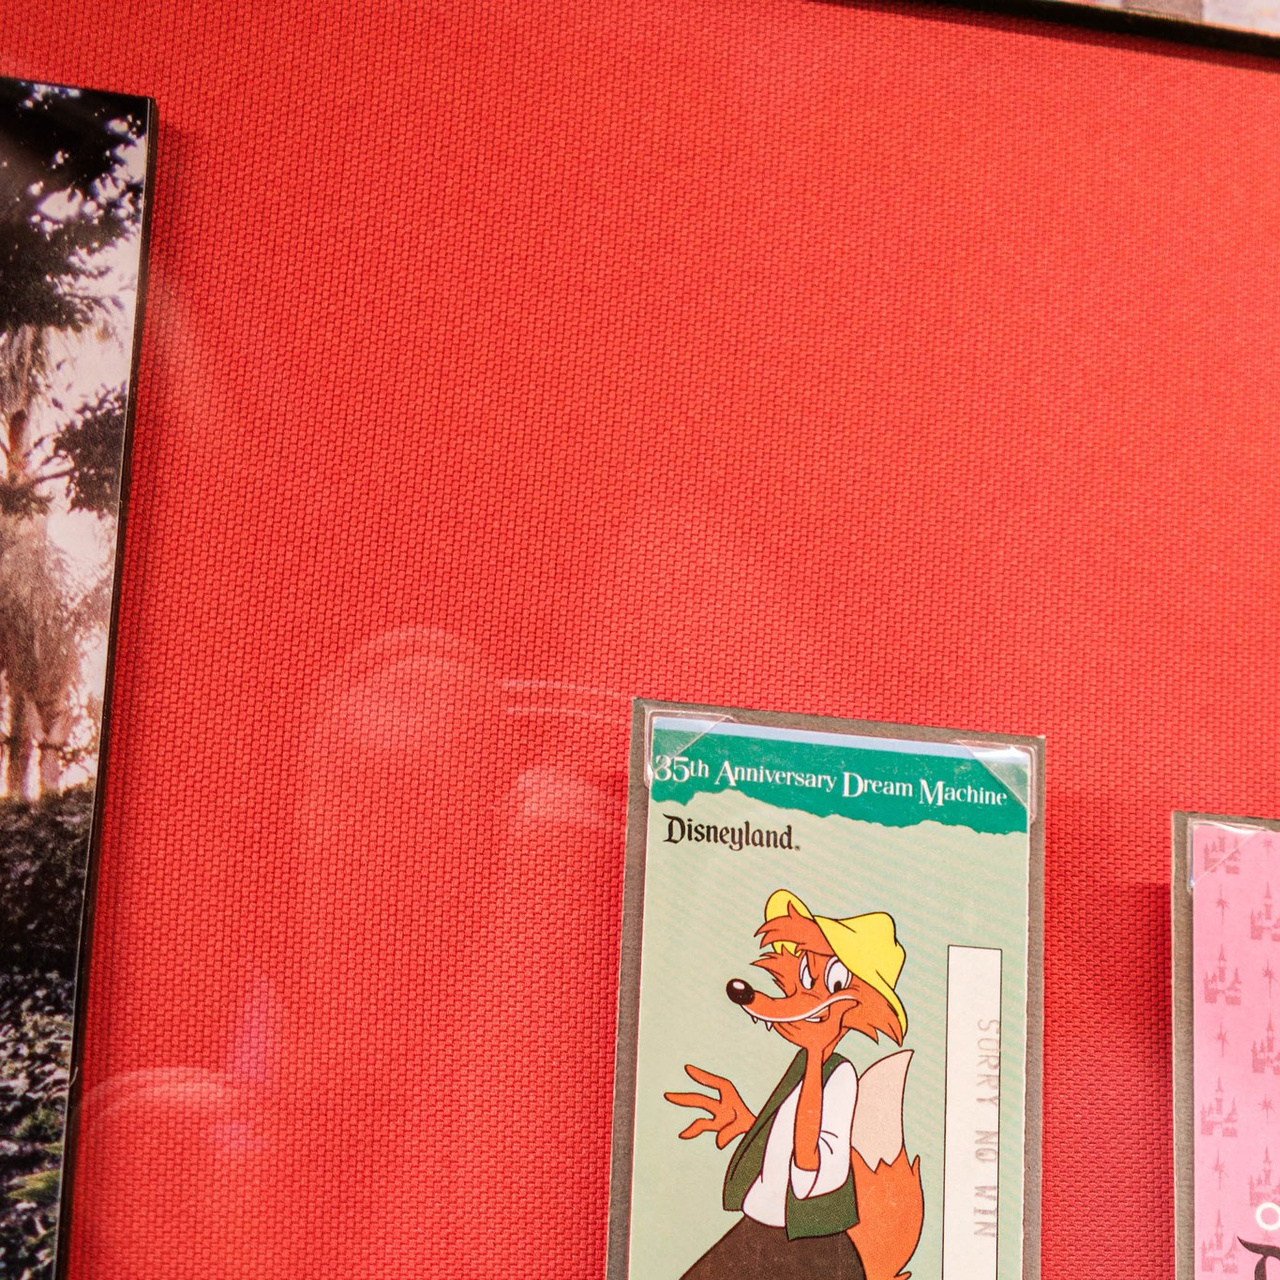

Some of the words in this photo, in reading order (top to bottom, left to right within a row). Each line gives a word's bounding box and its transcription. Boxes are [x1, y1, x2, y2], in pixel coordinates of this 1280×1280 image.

[654, 755, 709, 783] 35th
[714, 760, 837, 793] Anniversary
[842, 771, 913, 798] Dream
[919, 778, 1007, 806] Machine
[663, 813, 793, 851] Disneyland
[977, 1018, 1000, 1107] SORRY
[975, 1130, 999, 1162] NO
[974, 1185, 998, 1238] WIN
